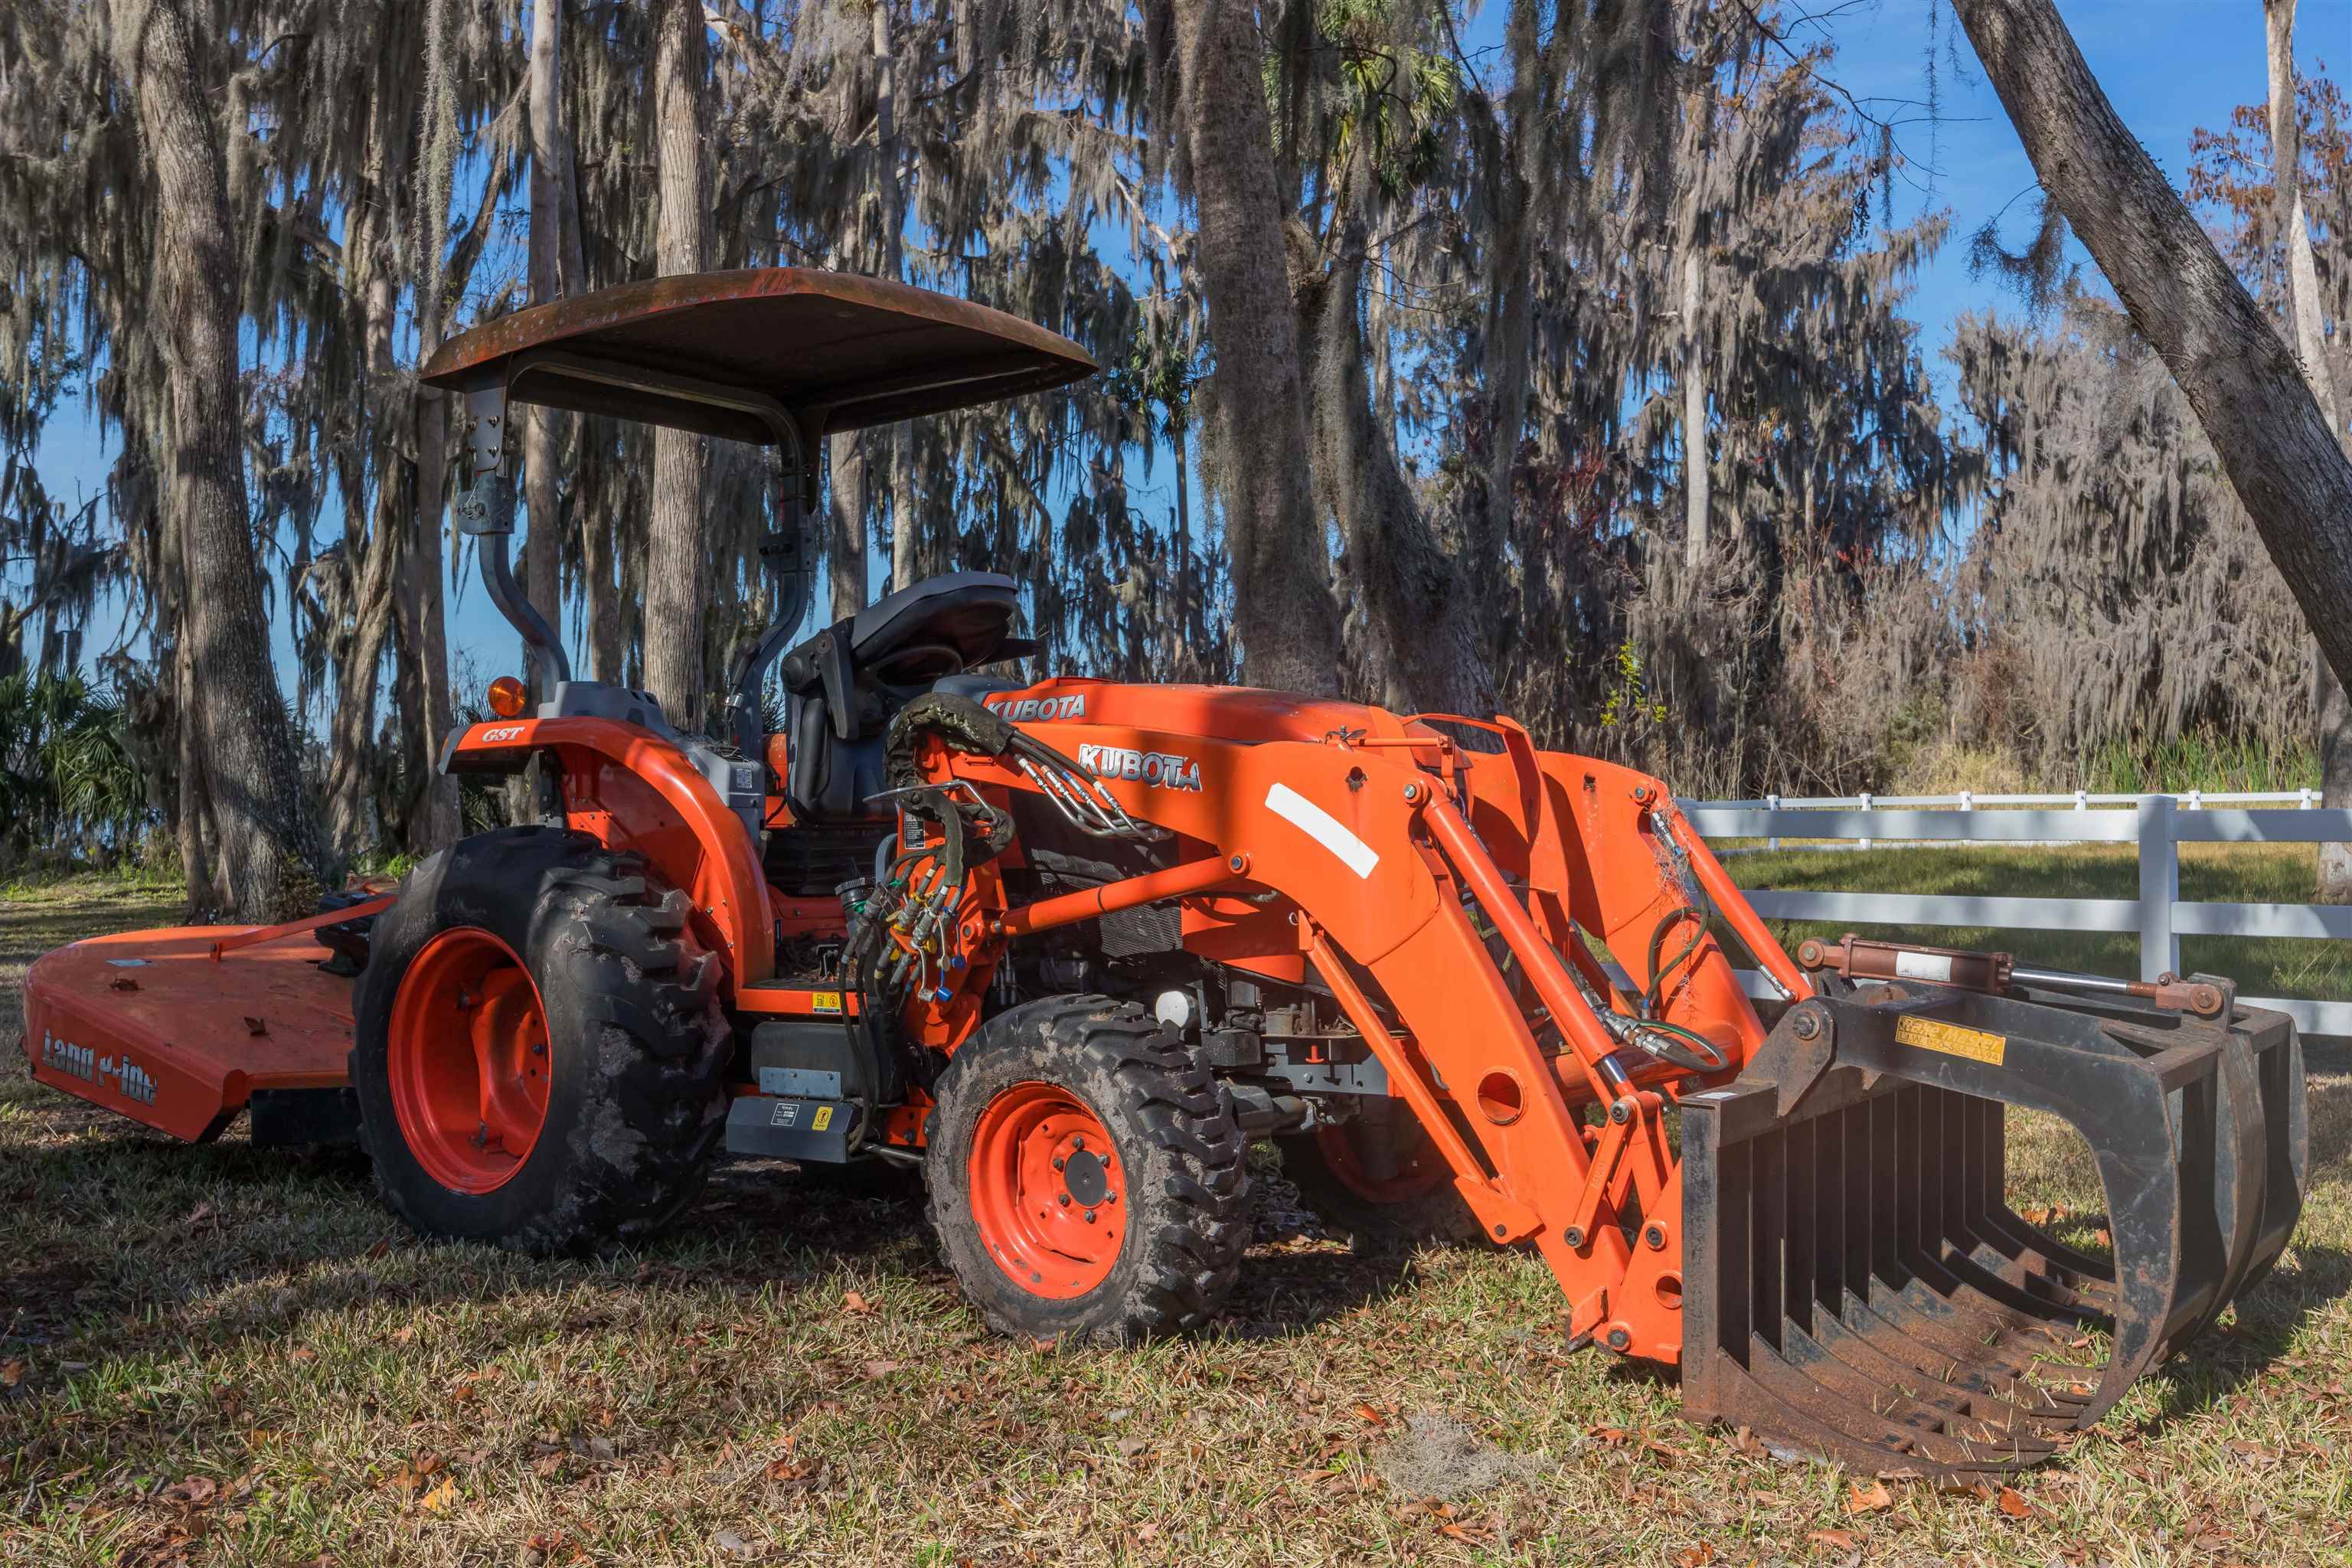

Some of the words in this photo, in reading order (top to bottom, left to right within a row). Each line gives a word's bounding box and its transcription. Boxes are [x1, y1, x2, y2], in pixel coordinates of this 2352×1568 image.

[988, 694, 1085, 722] KUBOTA
[482, 727, 525, 742] GST
[1079, 743, 1202, 792] KUBOTA
